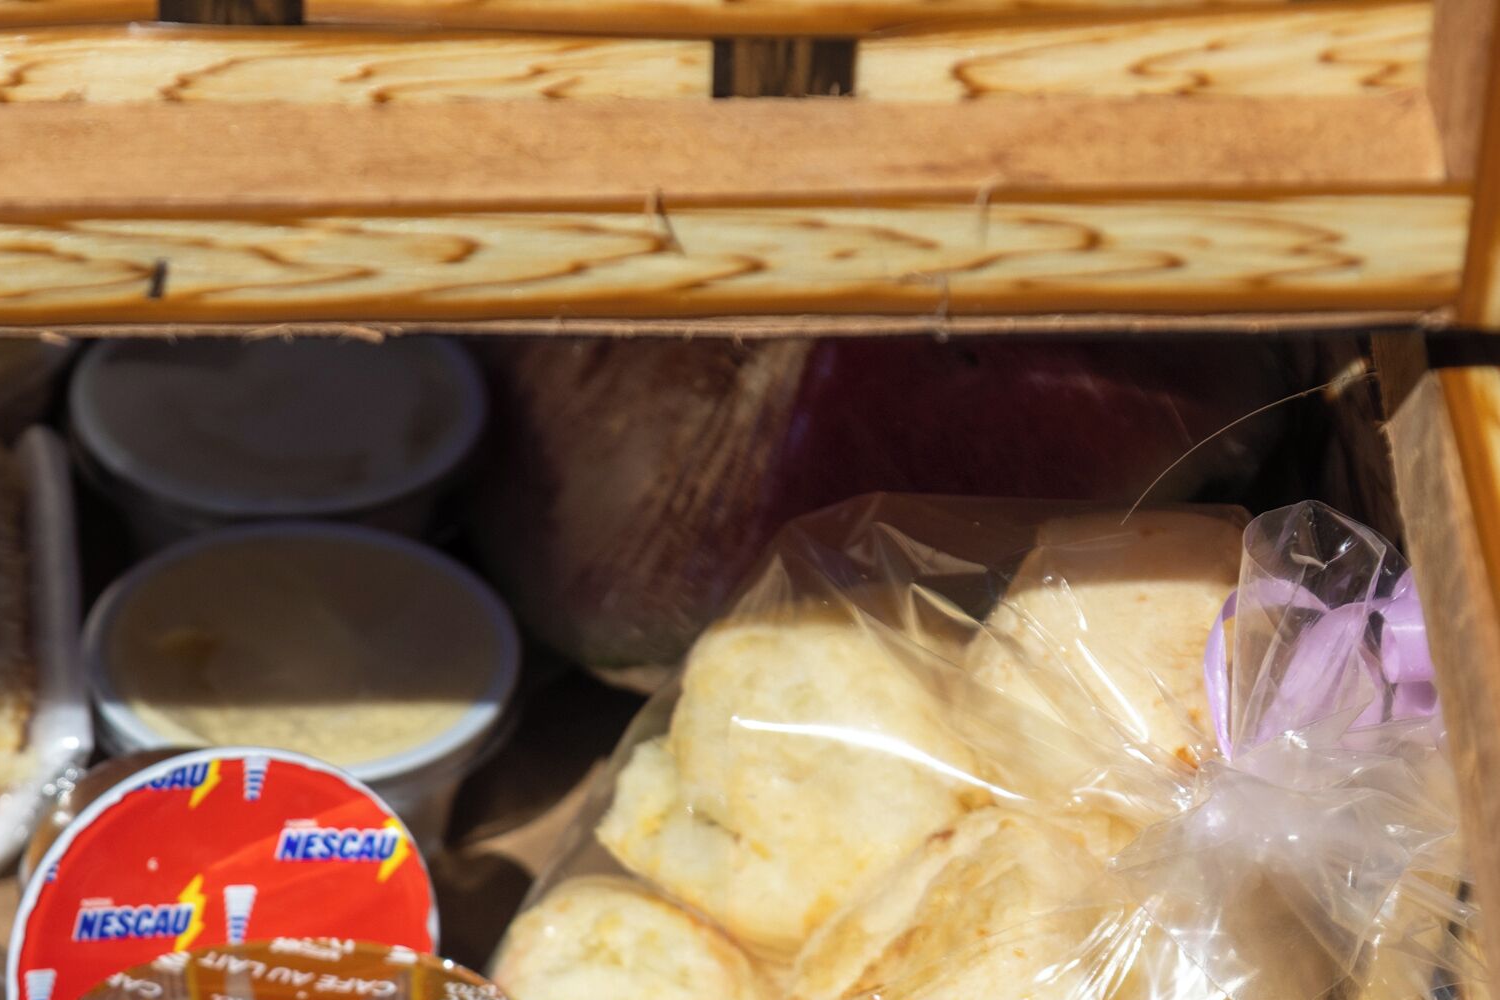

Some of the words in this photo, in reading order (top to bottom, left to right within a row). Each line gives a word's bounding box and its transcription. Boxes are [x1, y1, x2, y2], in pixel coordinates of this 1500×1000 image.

[275, 826, 401, 862] NESCAU
[73, 902, 196, 941] NESCAU
[198, 951, 267, 979] LAIT
[266, 966, 315, 986] AU
